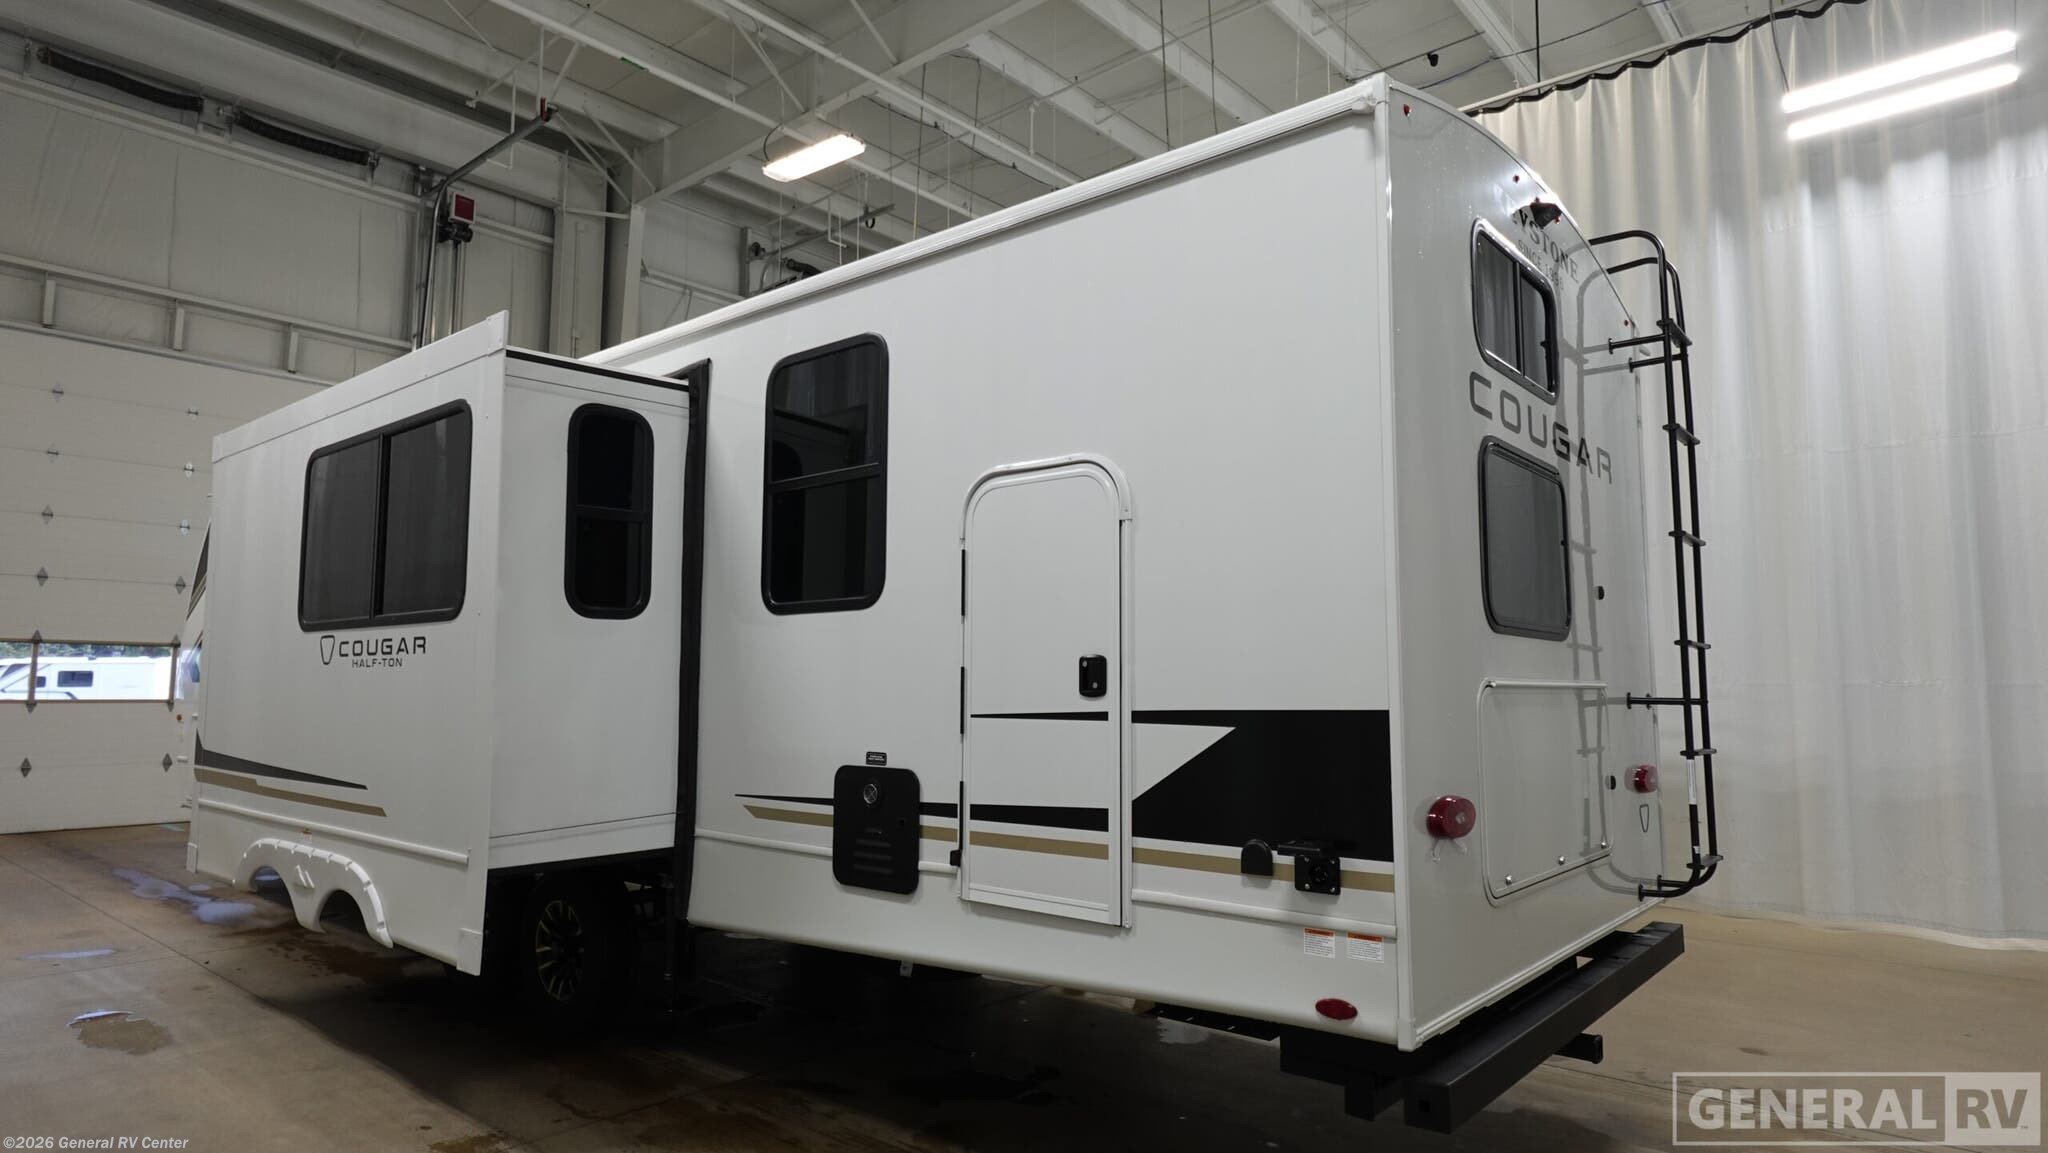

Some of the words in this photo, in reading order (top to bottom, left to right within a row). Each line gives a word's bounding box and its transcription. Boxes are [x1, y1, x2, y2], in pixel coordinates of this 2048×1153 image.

[1469, 371, 1613, 485] COUGAR
[339, 636, 427, 657] COUGAR
[351, 657, 403, 669] HALF-TON
